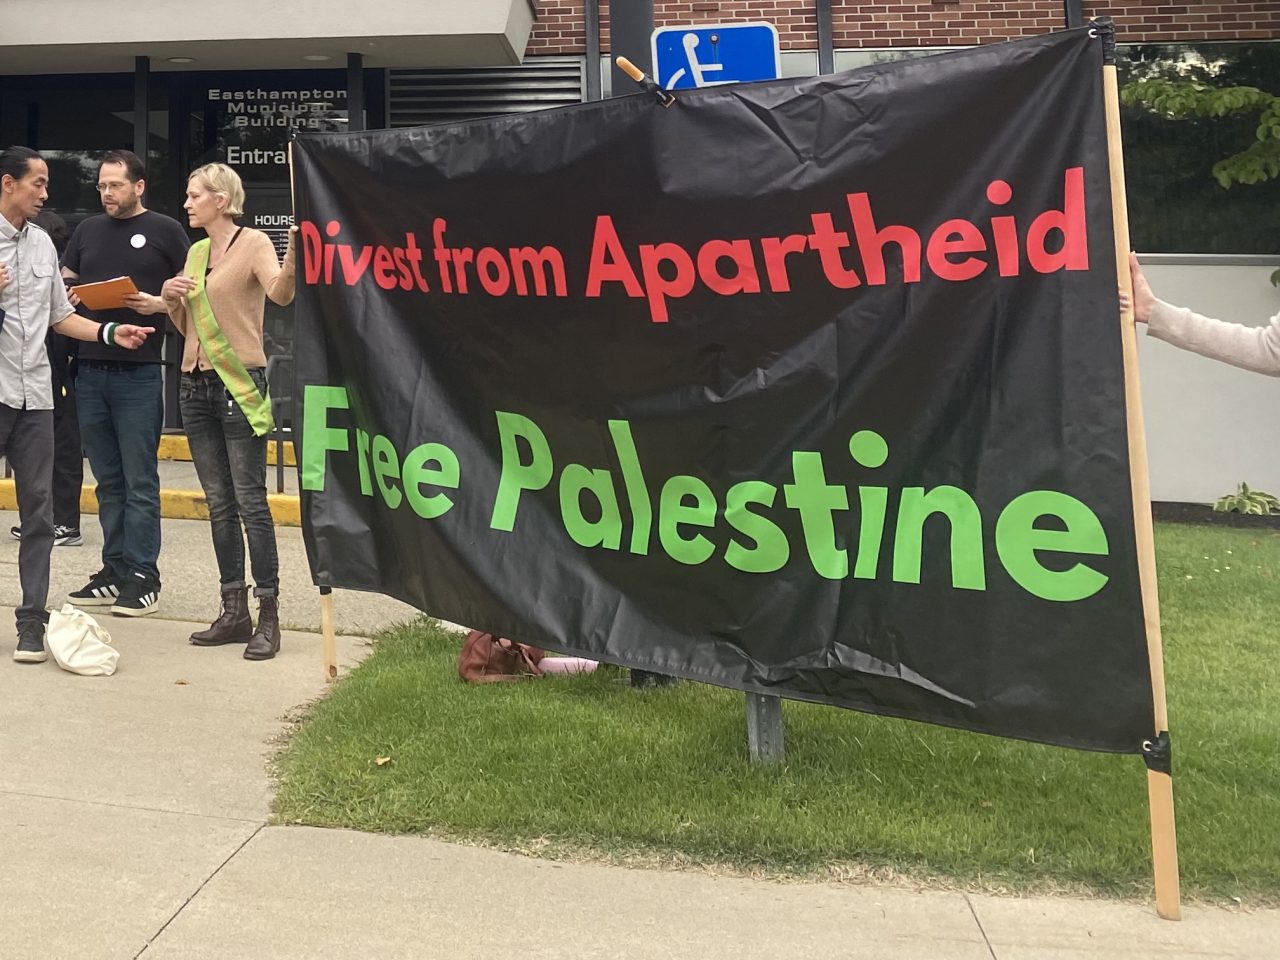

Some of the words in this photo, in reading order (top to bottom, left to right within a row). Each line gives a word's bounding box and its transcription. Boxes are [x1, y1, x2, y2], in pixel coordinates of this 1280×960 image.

[208, 89, 347, 101] Easthampton
[227, 102, 328, 115] Municipal
[234, 116, 320, 128] Building
[227, 146, 290, 165] Entra
[254, 215, 295, 226] HOURS
[300, 220, 430, 293] Divest
[433, 217, 568, 297] from
[585, 167, 1090, 323] Apartheid
[301, 384, 461, 520] Free
[489, 410, 1110, 602] Palestine
